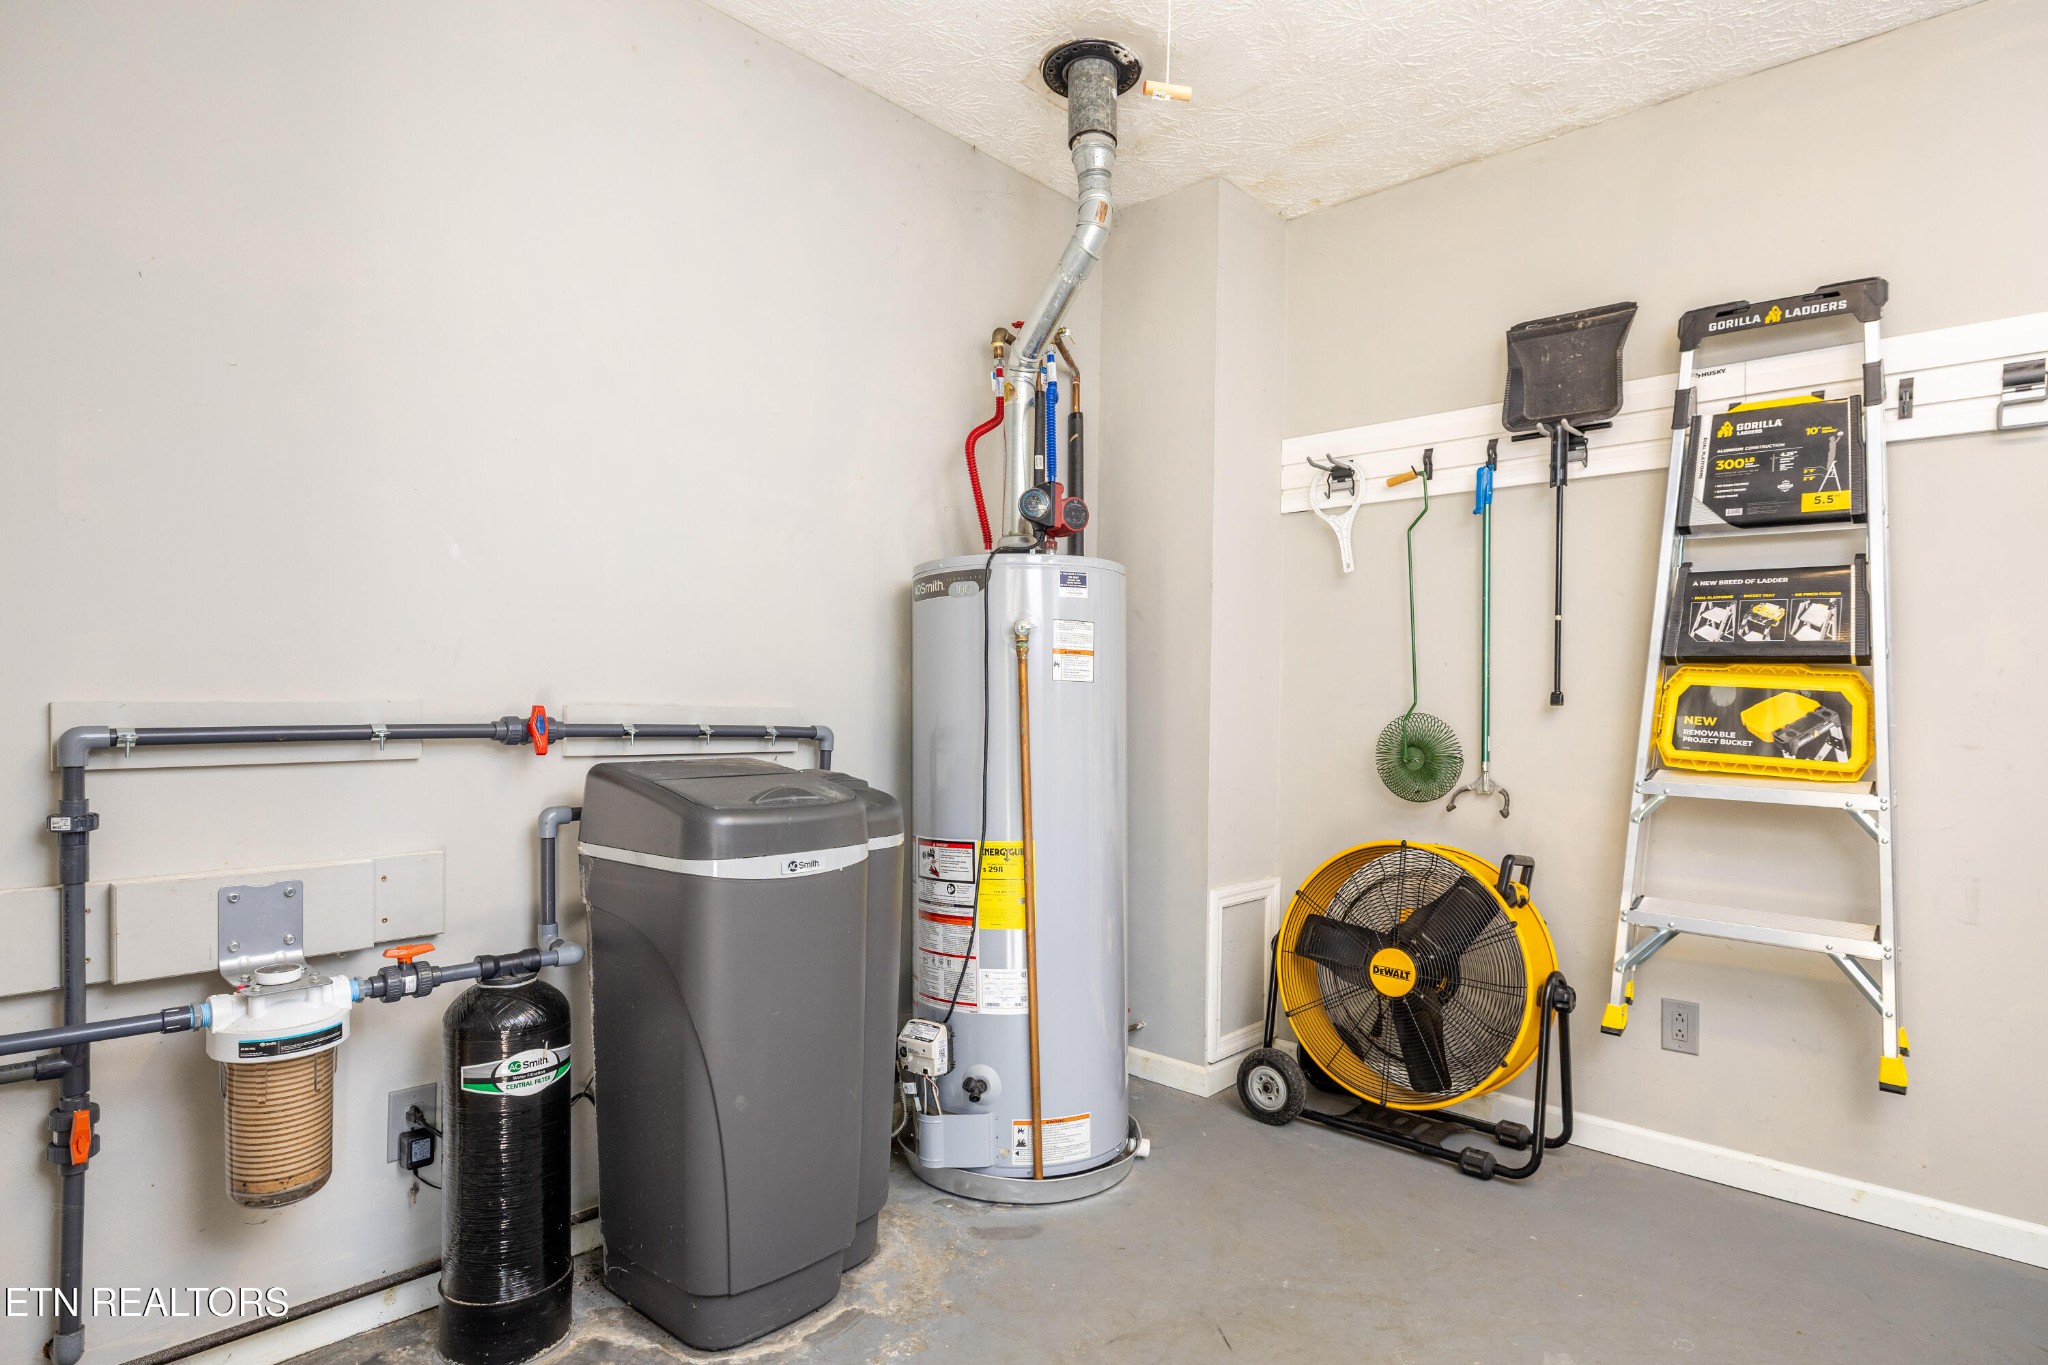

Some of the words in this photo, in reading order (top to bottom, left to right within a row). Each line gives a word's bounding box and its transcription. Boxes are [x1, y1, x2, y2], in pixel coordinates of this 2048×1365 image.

[1708, 314, 1762, 331] GORILLA
[1784, 300, 1847, 318] LADDERS
[1701, 368, 1726, 377] HUSKY
[1736, 419, 1783, 431] GORILLA
[1715, 458, 1745, 471] 300
[920, 579, 944, 595] Smith
[1683, 715, 1718, 727] NEW
[1683, 728, 1736, 739] REMOVABLE
[1682, 736, 1719, 745] PROJECT
[1720, 738, 1753, 747] BUCKET
[799, 859, 820, 869] Smith
[522, 1057, 548, 1069] Smith
[505, 1081, 533, 1090] CENTRAL
[534, 1075, 551, 1085] FILTER
